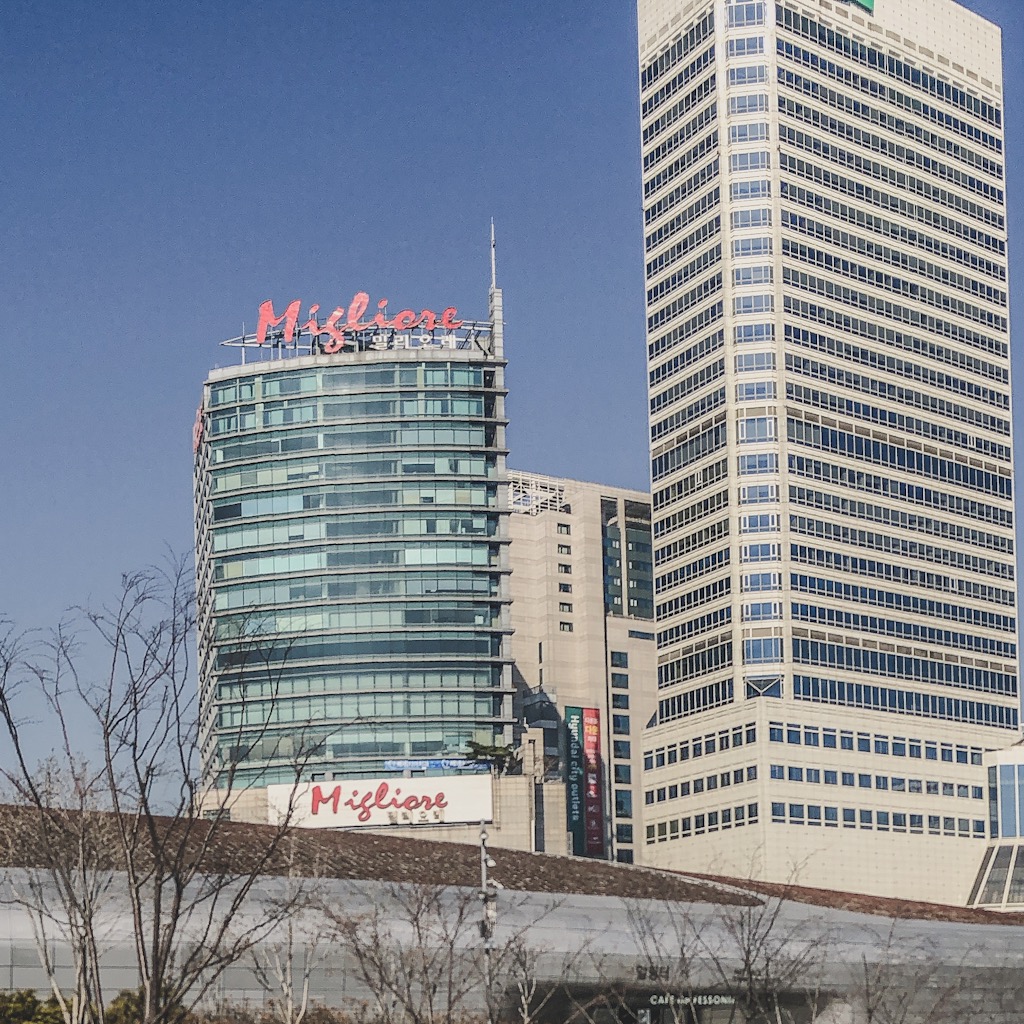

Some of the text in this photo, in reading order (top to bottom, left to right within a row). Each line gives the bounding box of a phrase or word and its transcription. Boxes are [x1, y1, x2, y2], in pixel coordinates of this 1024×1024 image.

[256, 291, 463, 353] Migliore
[567, 714, 581, 821] Hyundai city outlets
[311, 782, 448, 822] Migliore
